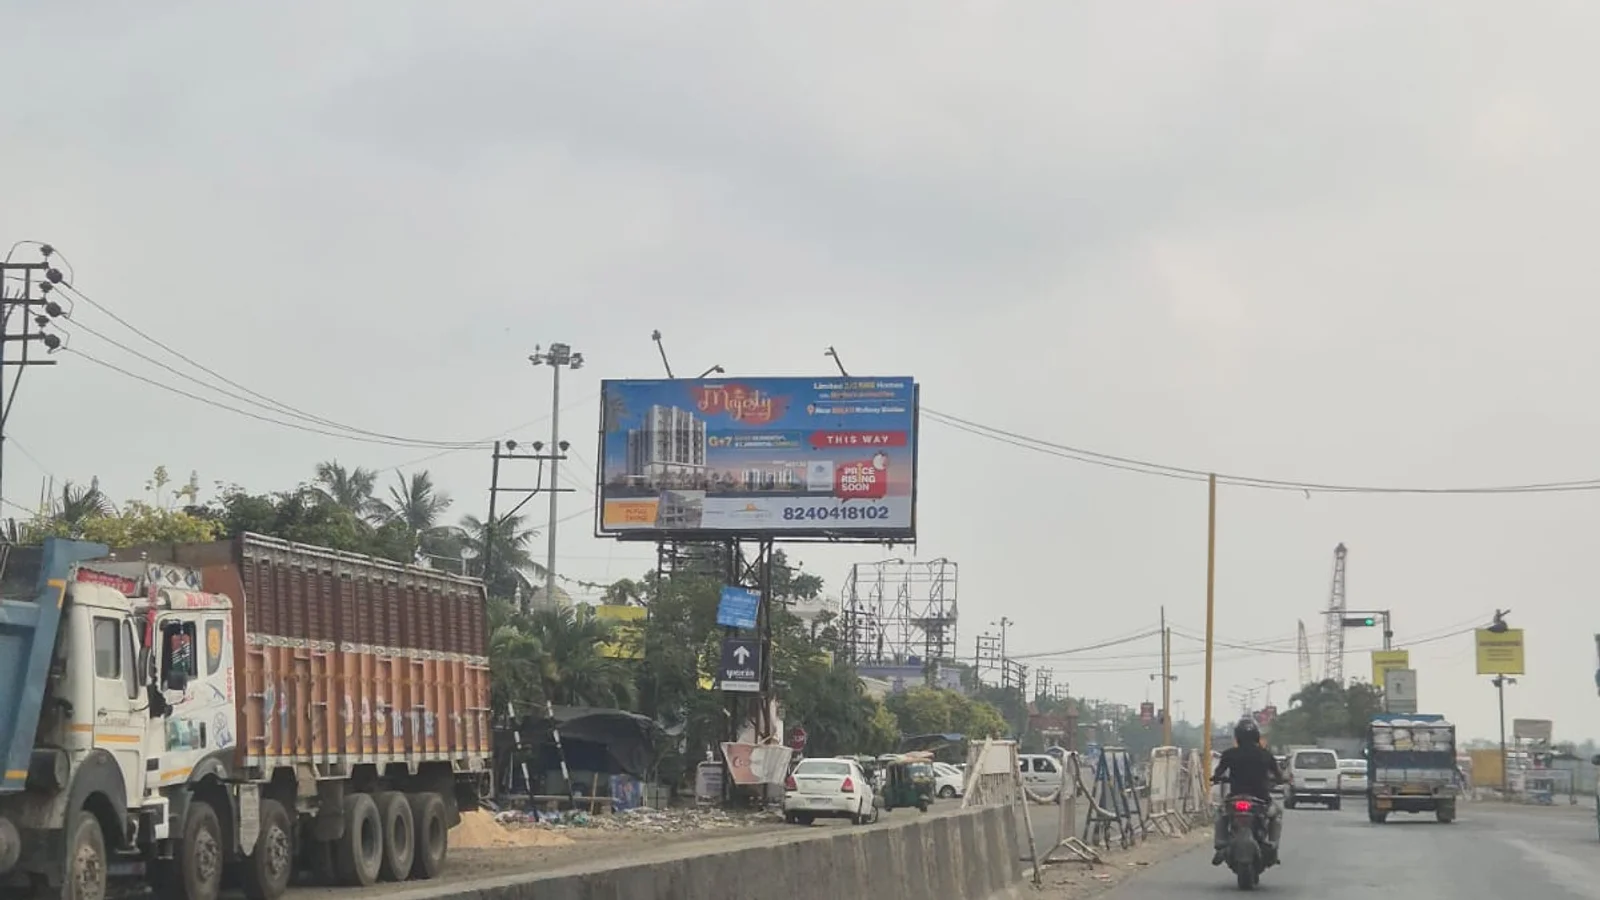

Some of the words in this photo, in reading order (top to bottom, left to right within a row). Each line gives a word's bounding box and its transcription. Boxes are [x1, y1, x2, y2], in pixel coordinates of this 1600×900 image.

[876, 380, 904, 389] Homes
[827, 435, 857, 444] THIS
[862, 435, 889, 444] WAY
[844, 466, 876, 476] PRICE
[841, 475, 876, 484] RISING
[841, 483, 870, 491] SOON
[783, 505, 889, 521] 8240418102
